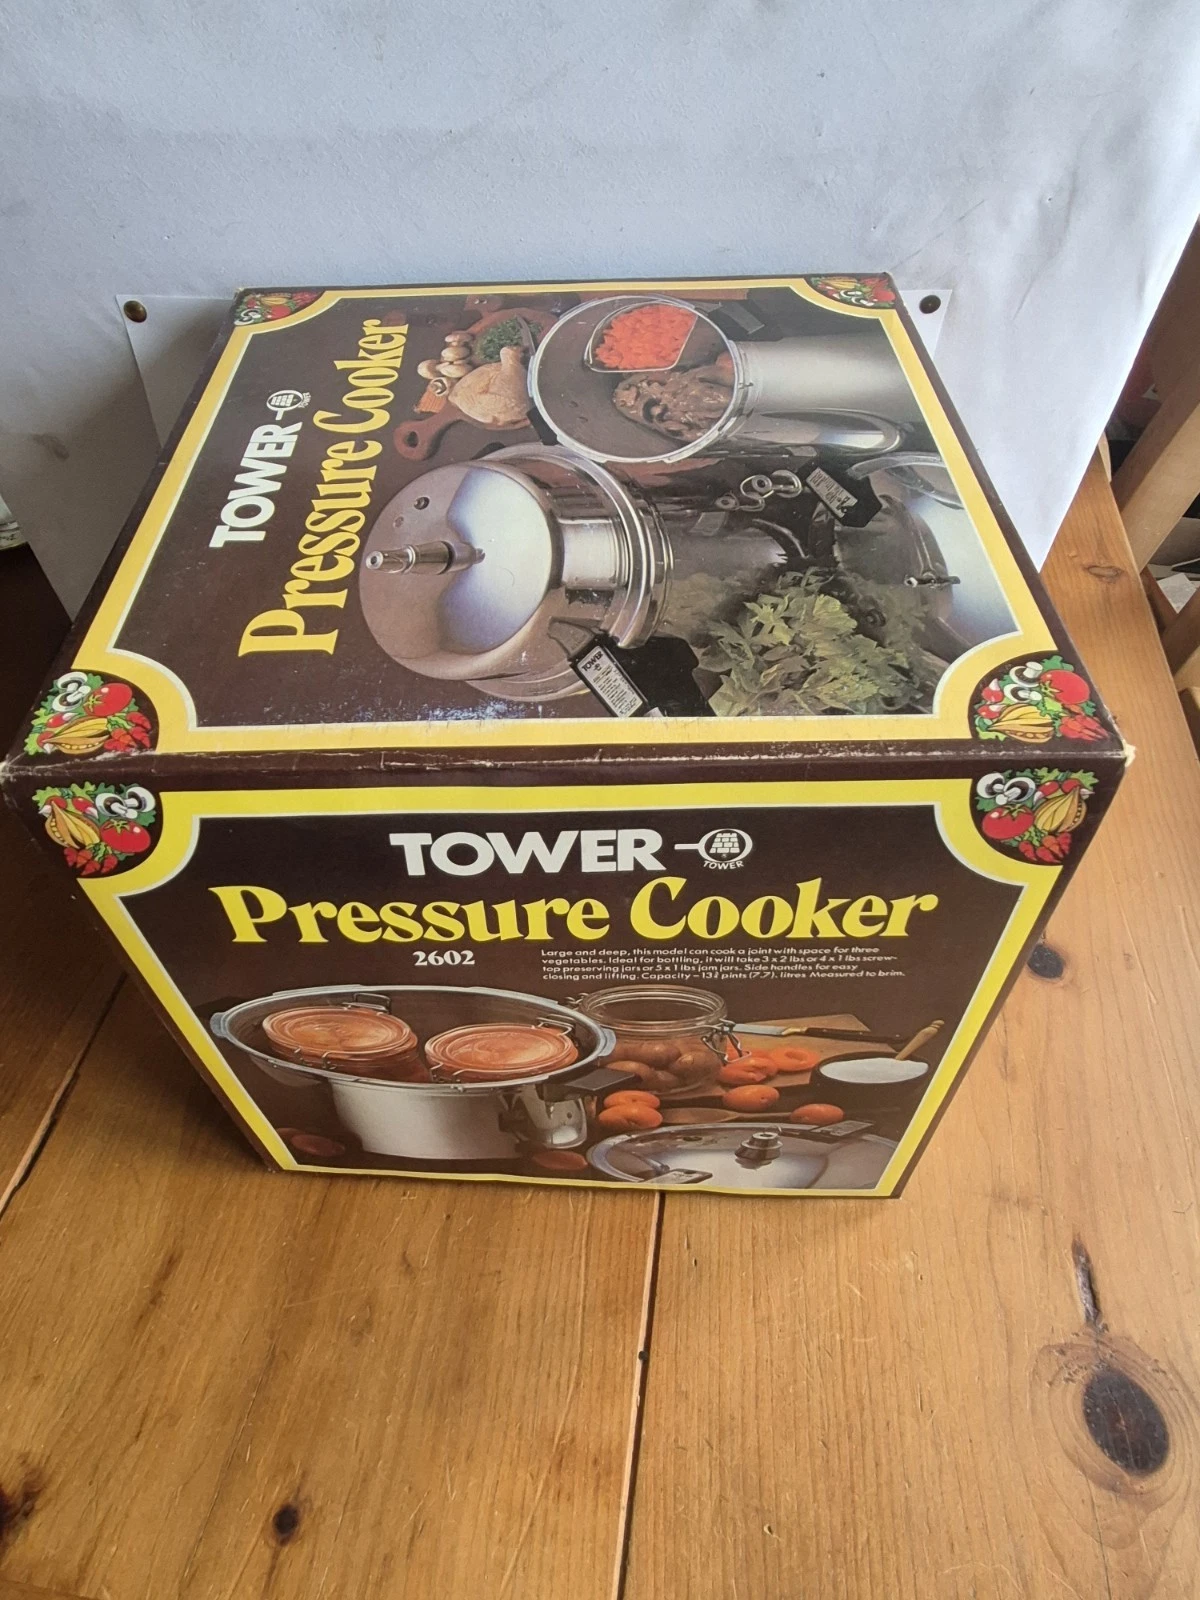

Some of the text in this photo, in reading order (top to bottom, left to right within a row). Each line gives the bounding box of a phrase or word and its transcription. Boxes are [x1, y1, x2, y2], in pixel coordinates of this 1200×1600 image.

[208, 421, 303, 549] TOWER
[238, 318, 409, 657] Pressure Cooker
[389, 828, 667, 876] TOWER
[703, 861, 744, 870] TOWER
[208, 876, 939, 944] Pressure Cooker
[413, 949, 476, 967] 2602
[541, 949, 573, 957] Large
[798, 947, 831, 955] space
[542, 957, 606, 965] vegetables.
[762, 955, 769, 963] 3
[780, 955, 787, 963] 2
[563, 965, 619, 973] preserving
[698, 964, 718, 972] jam
[720, 964, 742, 972] jars.
[744, 963, 769, 971] Side
[641, 972, 691, 980] Capacity
[721, 972, 747, 980] pints
[810, 970, 864, 978] Measured
